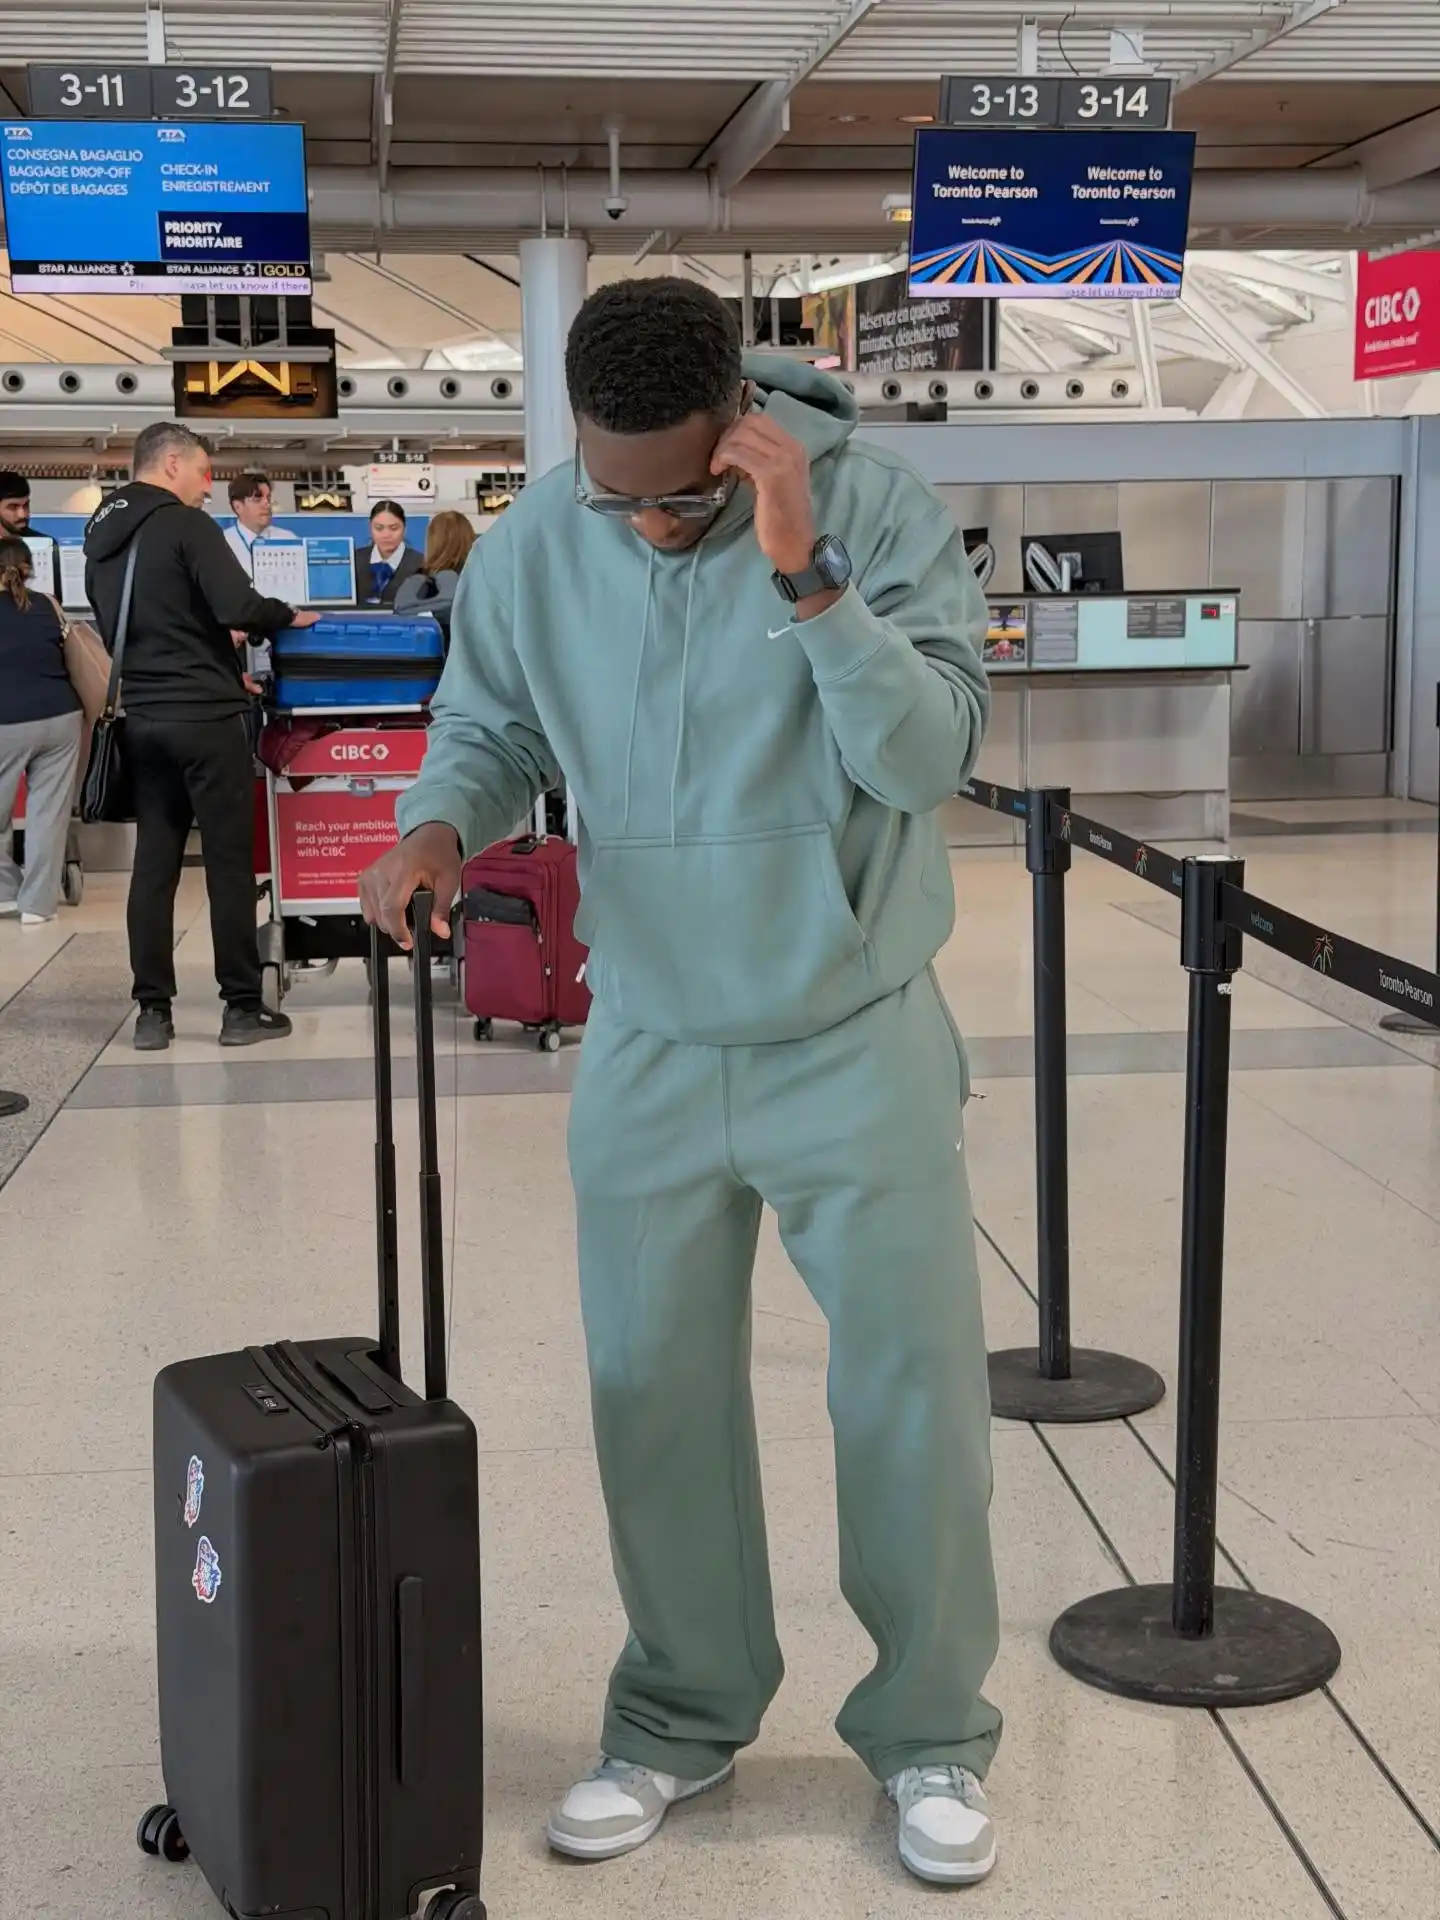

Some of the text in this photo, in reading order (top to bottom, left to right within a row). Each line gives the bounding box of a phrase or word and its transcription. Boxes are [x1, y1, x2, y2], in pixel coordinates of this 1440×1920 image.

[59, 73, 124, 106] 3-11
[175, 75, 250, 108] 3-12
[970, 84, 1039, 117] 3-13
[1077, 85, 1149, 118] 3-14
[7, 148, 143, 162] CONSEGNA BAGAGLIO
[9, 166, 132, 179] BAGGAGE DROP-OFF
[160, 163, 218, 176] CHECK-IN
[948, 165, 1024, 180] Welcome to
[1087, 165, 1163, 181] Welcome to
[10, 181, 128, 196] DÉPÔT DE BAGAGES
[162, 180, 271, 193] ENREGISTREMENT
[932, 183, 1038, 198] Toronto Pearson
[1071, 184, 1176, 199] Toronto Pearson
[164, 221, 223, 234] PRIORITY
[166, 235, 243, 249] PRIORITAIRE
[38, 264, 118, 274] STAR ALLIANCE
[166, 264, 239, 275] STAR ALLIANCE
[264, 265, 306, 277] GOLD
[227, 282, 238, 291] us
[241, 281, 269, 291] know
[1364, 291, 1403, 328] CIBC
[330, 744, 371, 760] CIBC
[295, 820, 326, 832] Reach
[328, 823, 350, 832] your
[296, 833, 315, 844] and
[317, 836, 340, 846] your
[297, 845, 346, 857] with CIBC
[1378, 968, 1433, 1007] Toronto Pearson
